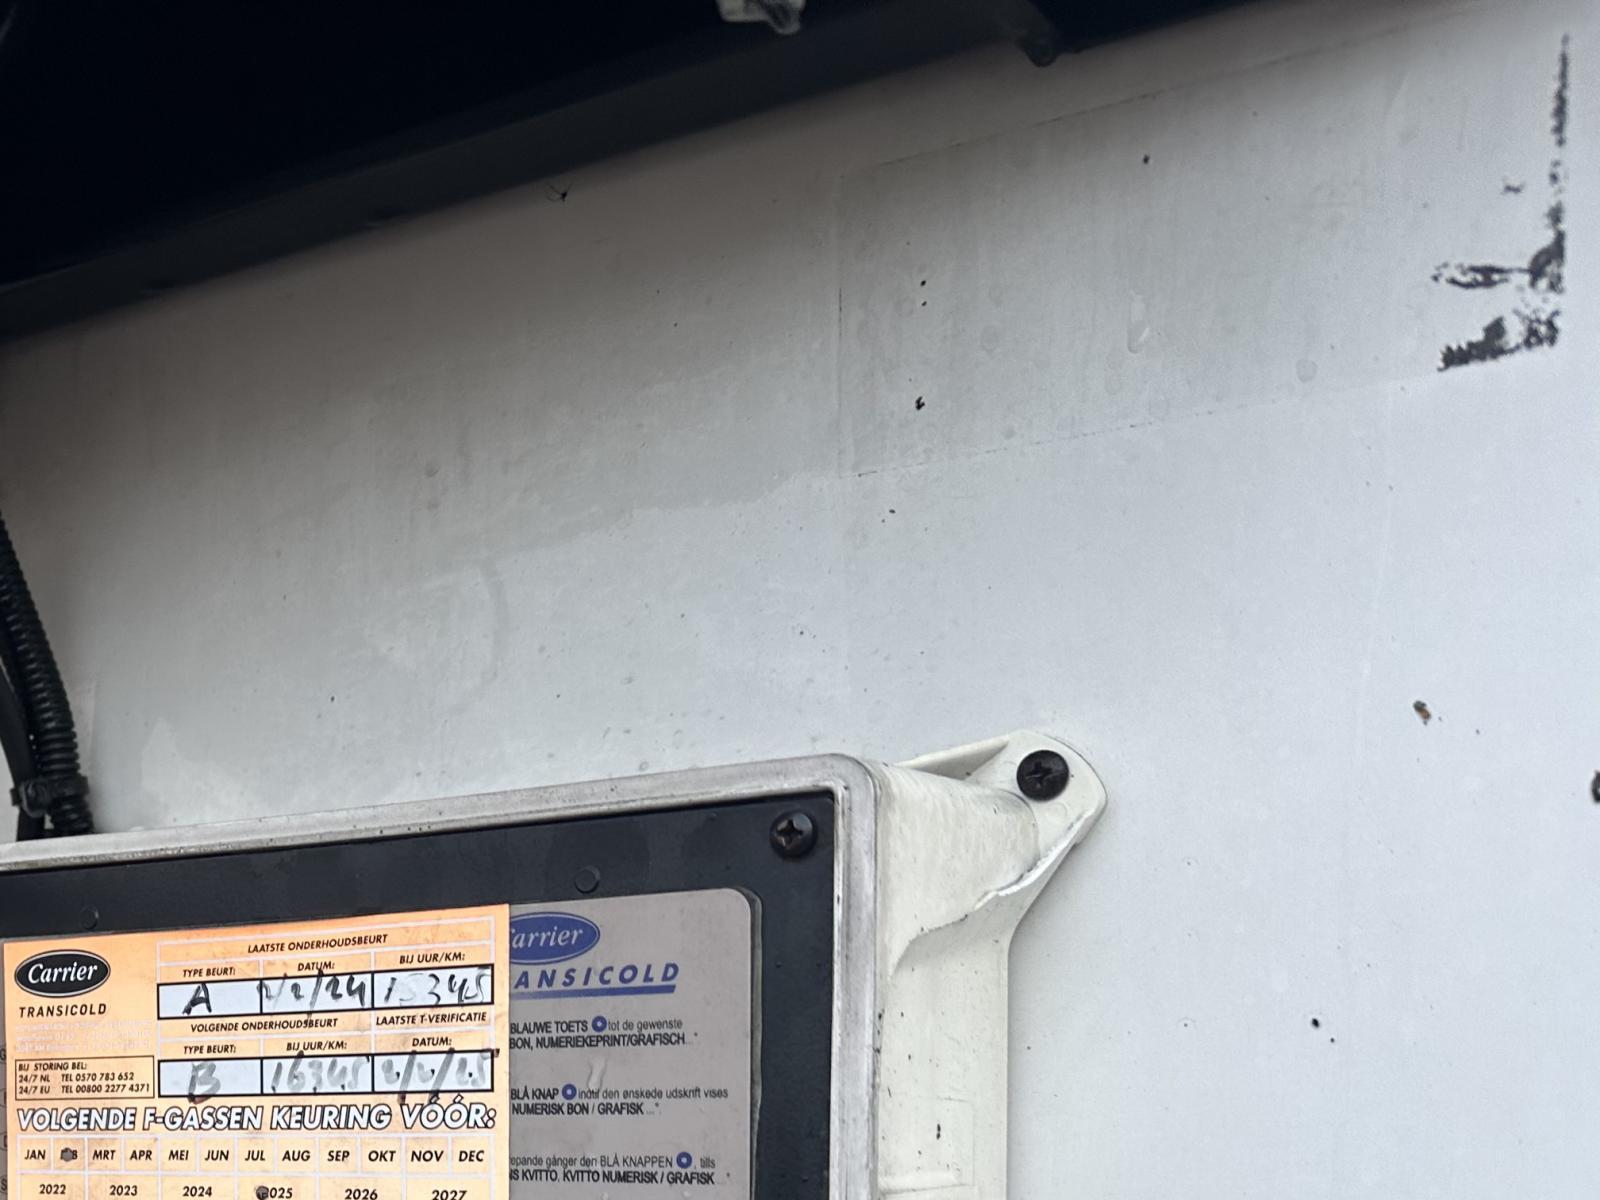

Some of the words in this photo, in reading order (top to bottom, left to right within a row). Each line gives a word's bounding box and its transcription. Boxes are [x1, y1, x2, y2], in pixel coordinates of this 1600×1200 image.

[510, 925, 583, 949] arrier
[247, 942, 285, 954] LAATSTE
[288, 934, 388, 951] ONDERHOUDSBEURT
[400, 955, 414, 964] BIJ
[417, 952, 465, 963] UUR/KM:
[27, 961, 98, 984] Carrier
[183, 969, 203, 978] TYPE
[206, 966, 236, 977] BEURT:
[297, 961, 335, 972] DATUM:
[182, 981, 212, 1015] A
[19, 1003, 107, 1018] TRANSICOLD
[376, 1014, 416, 1026] LAATSTE
[420, 1011, 487, 1024] T-VERIFICATIE
[191, 1022, 238, 1033] VOLGENDE
[241, 1018, 338, 1031] ONDERHOUDSBEURT
[510, 1021, 552, 1034] BLAUWE
[555, 1021, 588, 1032] TOETS
[608, 1021, 620, 1031] tot
[622, 1020, 634, 1031] de
[636, 1019, 683, 1033] gewenste
[286, 1042, 300, 1051] BIJ
[302, 1040, 347, 1051] UUR/KM:
[412, 1036, 452, 1047] DATUM:
[184, 1045, 204, 1054] TYPE
[206, 1043, 236, 1054] BEURT:
[34, 1062, 69, 1072] STORING
[71, 1061, 87, 1071] BEL:
[18, 1075, 37, 1083] 24/7
[40, 1074, 50, 1083] NL
[61, 1074, 73, 1082] TEL
[75, 1073, 97, 1082] 0570
[99, 1072, 115, 1081] 783
[117, 1072, 134, 1081] 652
[187, 1061, 221, 1104] B
[18, 1086, 37, 1094] 24/7
[40, 1086, 50, 1094] EU
[61, 1085, 73, 1094] TEL
[75, 1084, 102, 1093] 00800
[104, 1084, 127, 1093] 2277
[128, 1083, 150, 1092] 4371
[510, 1086, 529, 1100] BLÅ
[531, 1088, 559, 1100] KNAP
[602, 1088, 619, 1099] den
[622, 1088, 663, 1099] ønskede
[665, 1087, 701, 1098] udskrift
[703, 1088, 729, 1098] vises
[16, 1106, 137, 1132] VOLGENDE
[142, 1105, 264, 1132] F-GASSEN
[270, 1103, 393, 1130] KEURING
[400, 1094, 497, 1130] VÓÓR:
[512, 1103, 565, 1115] NUMERISK
[567, 1103, 590, 1115] BON
[24, 1150, 46, 1161] JAN
[60, 1149, 78, 1161] FB
[92, 1150, 116, 1161] MRT
[130, 1150, 153, 1161] APR
[168, 1150, 189, 1161] MEI
[204, 1150, 230, 1161] JUN
[244, 1150, 266, 1161] JUL
[282, 1150, 311, 1162] AUG
[327, 1150, 350, 1162] SEP
[368, 1150, 397, 1162] OKT
[410, 1150, 444, 1162] NOV
[458, 1150, 485, 1162] DEC
[600, 1154, 619, 1168] BLÅ
[622, 1156, 673, 1168] KNAPPEN
[563, 1169, 600, 1182] KVITTO
[602, 1171, 658, 1184] NUMERISK
[39, 1184, 66, 1195] 2022
[109, 1185, 138, 1196] 2023
[182, 1186, 212, 1197] 2024
[258, 1187, 293, 1199] 025
[344, 1188, 378, 1200] 2026
